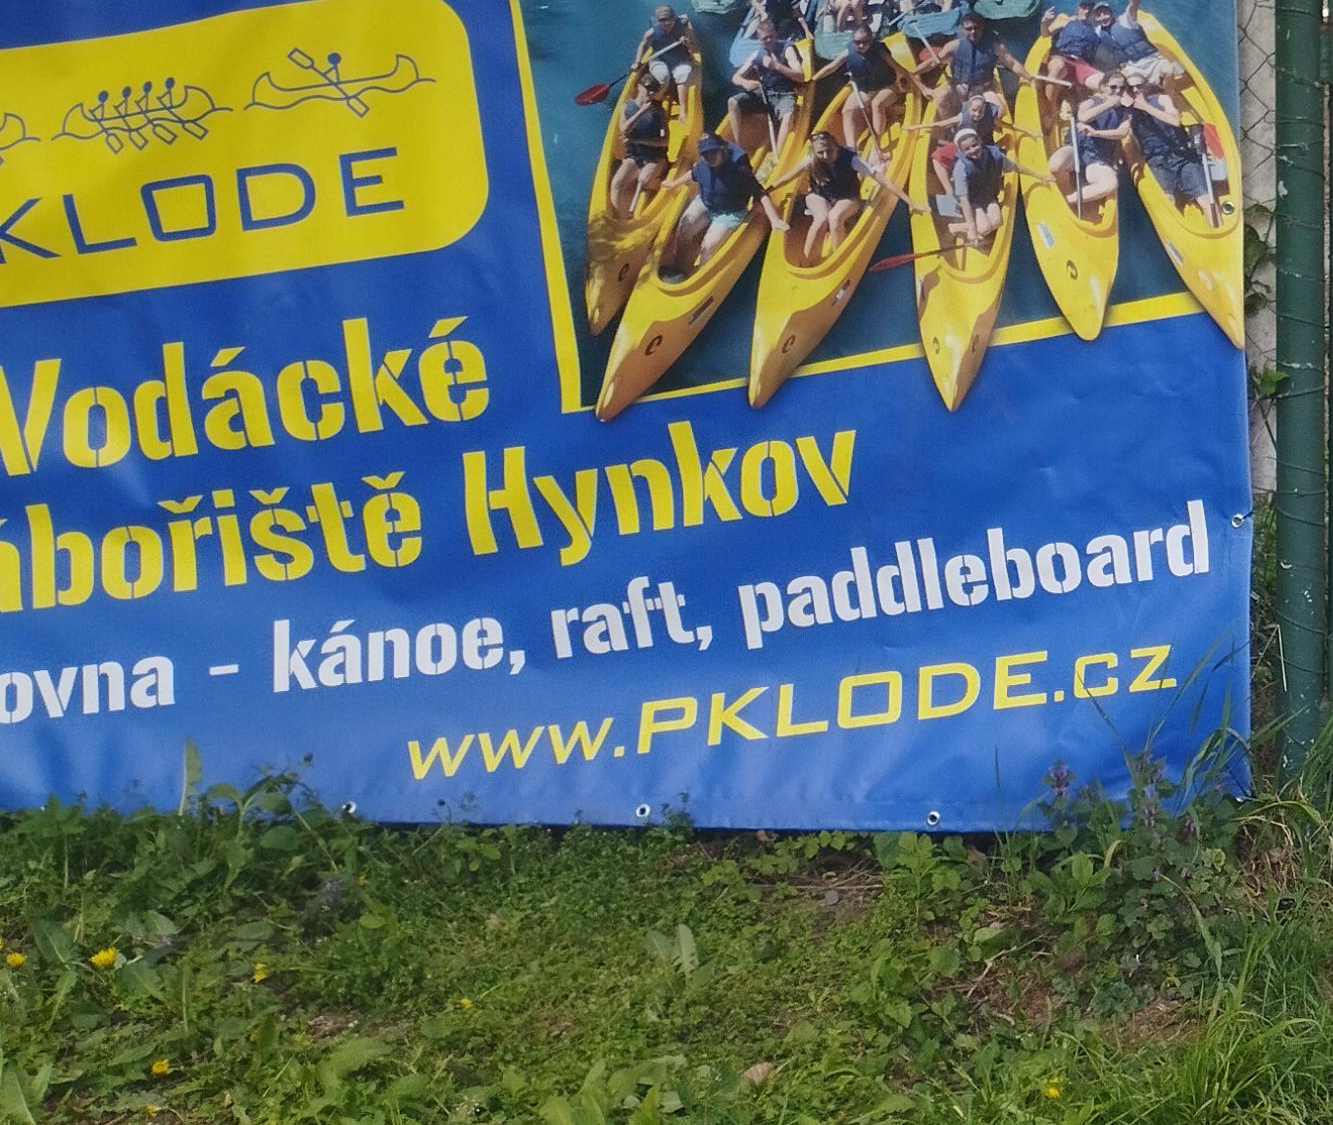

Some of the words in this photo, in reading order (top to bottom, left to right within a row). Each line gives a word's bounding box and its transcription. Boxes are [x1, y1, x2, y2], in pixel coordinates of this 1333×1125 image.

[0, 317, 488, 476] Vodácké
[463, 420, 856, 566] Hynkov
[0, 655, 175, 725] ovna
[273, 617, 526, 693] kánoe,
[550, 576, 713, 659] raft,
[738, 499, 1210, 651] paddleboard
